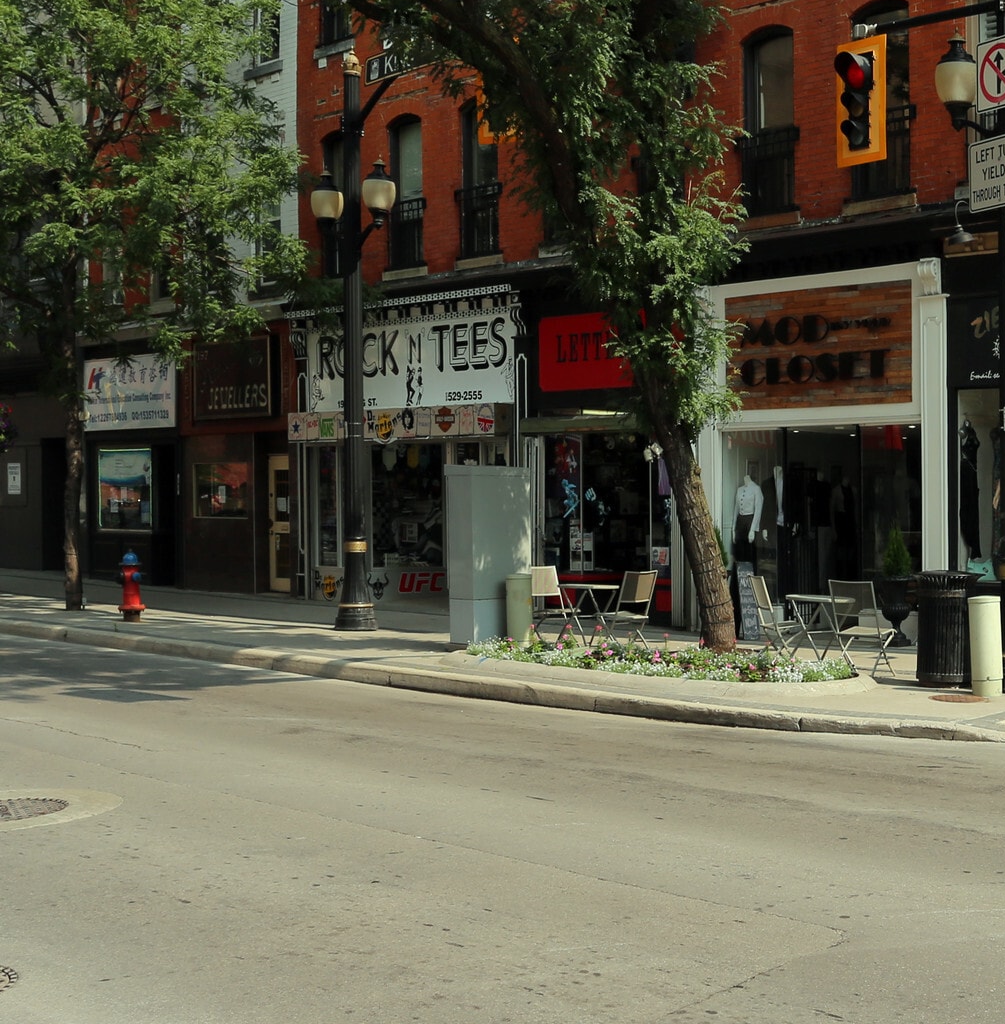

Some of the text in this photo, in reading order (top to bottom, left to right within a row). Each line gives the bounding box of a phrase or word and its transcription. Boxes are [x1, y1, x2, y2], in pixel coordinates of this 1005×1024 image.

[975, 146, 995, 164] LEFT
[982, 164, 1005, 181] YIELD
[972, 184, 1001, 204] THROUGH
[741, 315, 829, 347] MOD
[427, 317, 507, 372] TEES
[742, 349, 891, 386] CLOSET
[208, 383, 268, 410] JEWELLERS
[368, 398, 378, 407] ST.
[448, 390, 483, 402] 529-2555
[398, 572, 446, 593] UFC
